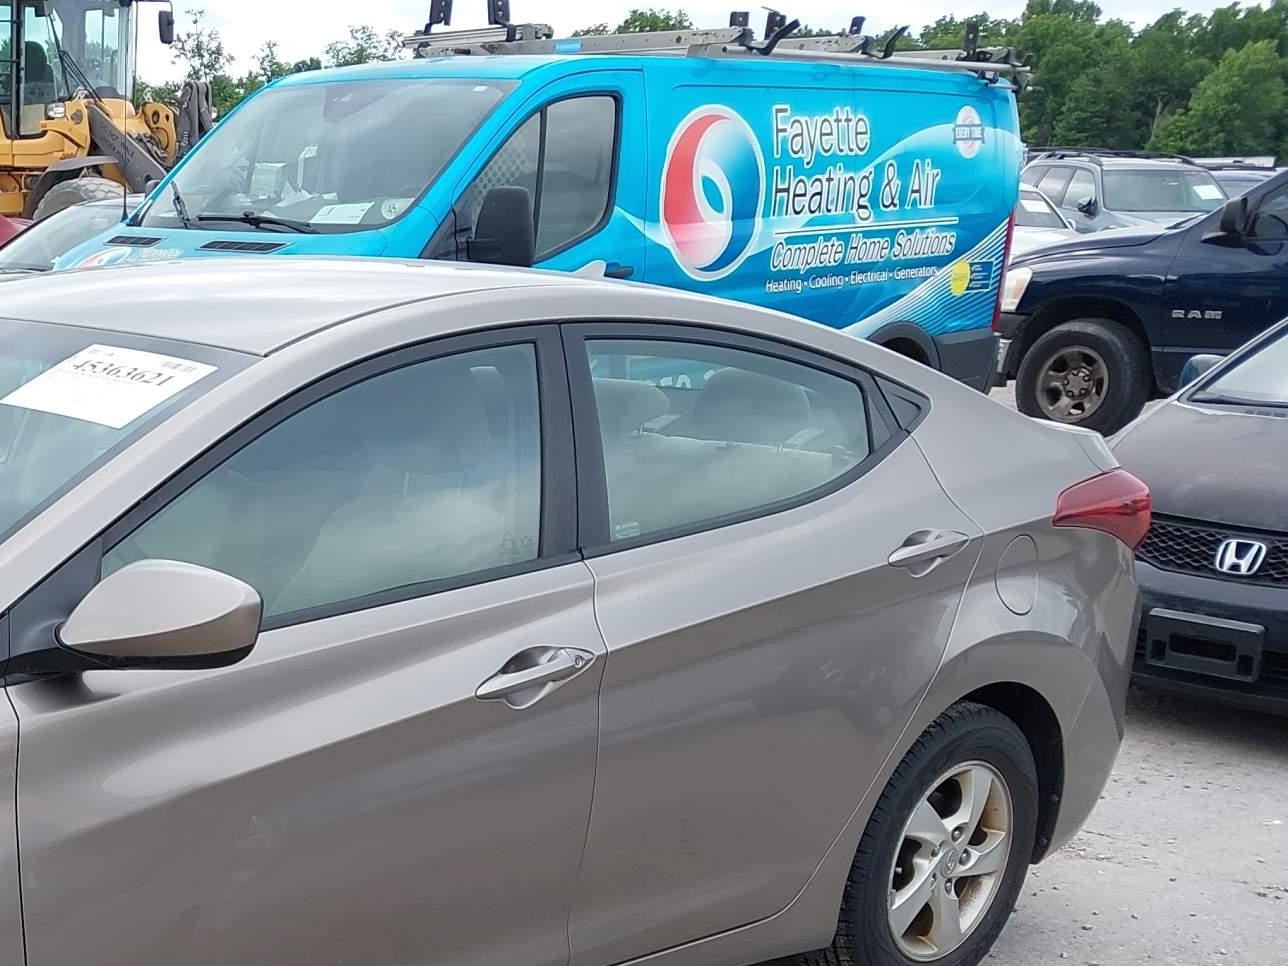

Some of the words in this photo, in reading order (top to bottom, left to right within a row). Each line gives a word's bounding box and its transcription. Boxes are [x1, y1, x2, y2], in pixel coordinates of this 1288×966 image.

[773, 106, 870, 166] Fayette
[772, 162, 874, 221] Heating
[880, 161, 902, 209] &
[906, 159, 941, 209] Air
[771, 236, 843, 272] Complete
[845, 233, 890, 264] Home
[893, 231, 956, 258] Solutions
[766, 279, 802, 294] Heating
[808, 274, 843, 290] Cooling
[850, 269, 888, 285] Electrical
[894, 266, 938, 281] Generators
[1172, 309, 1223, 319] RAM
[72, 359, 176, 386] 45363621
